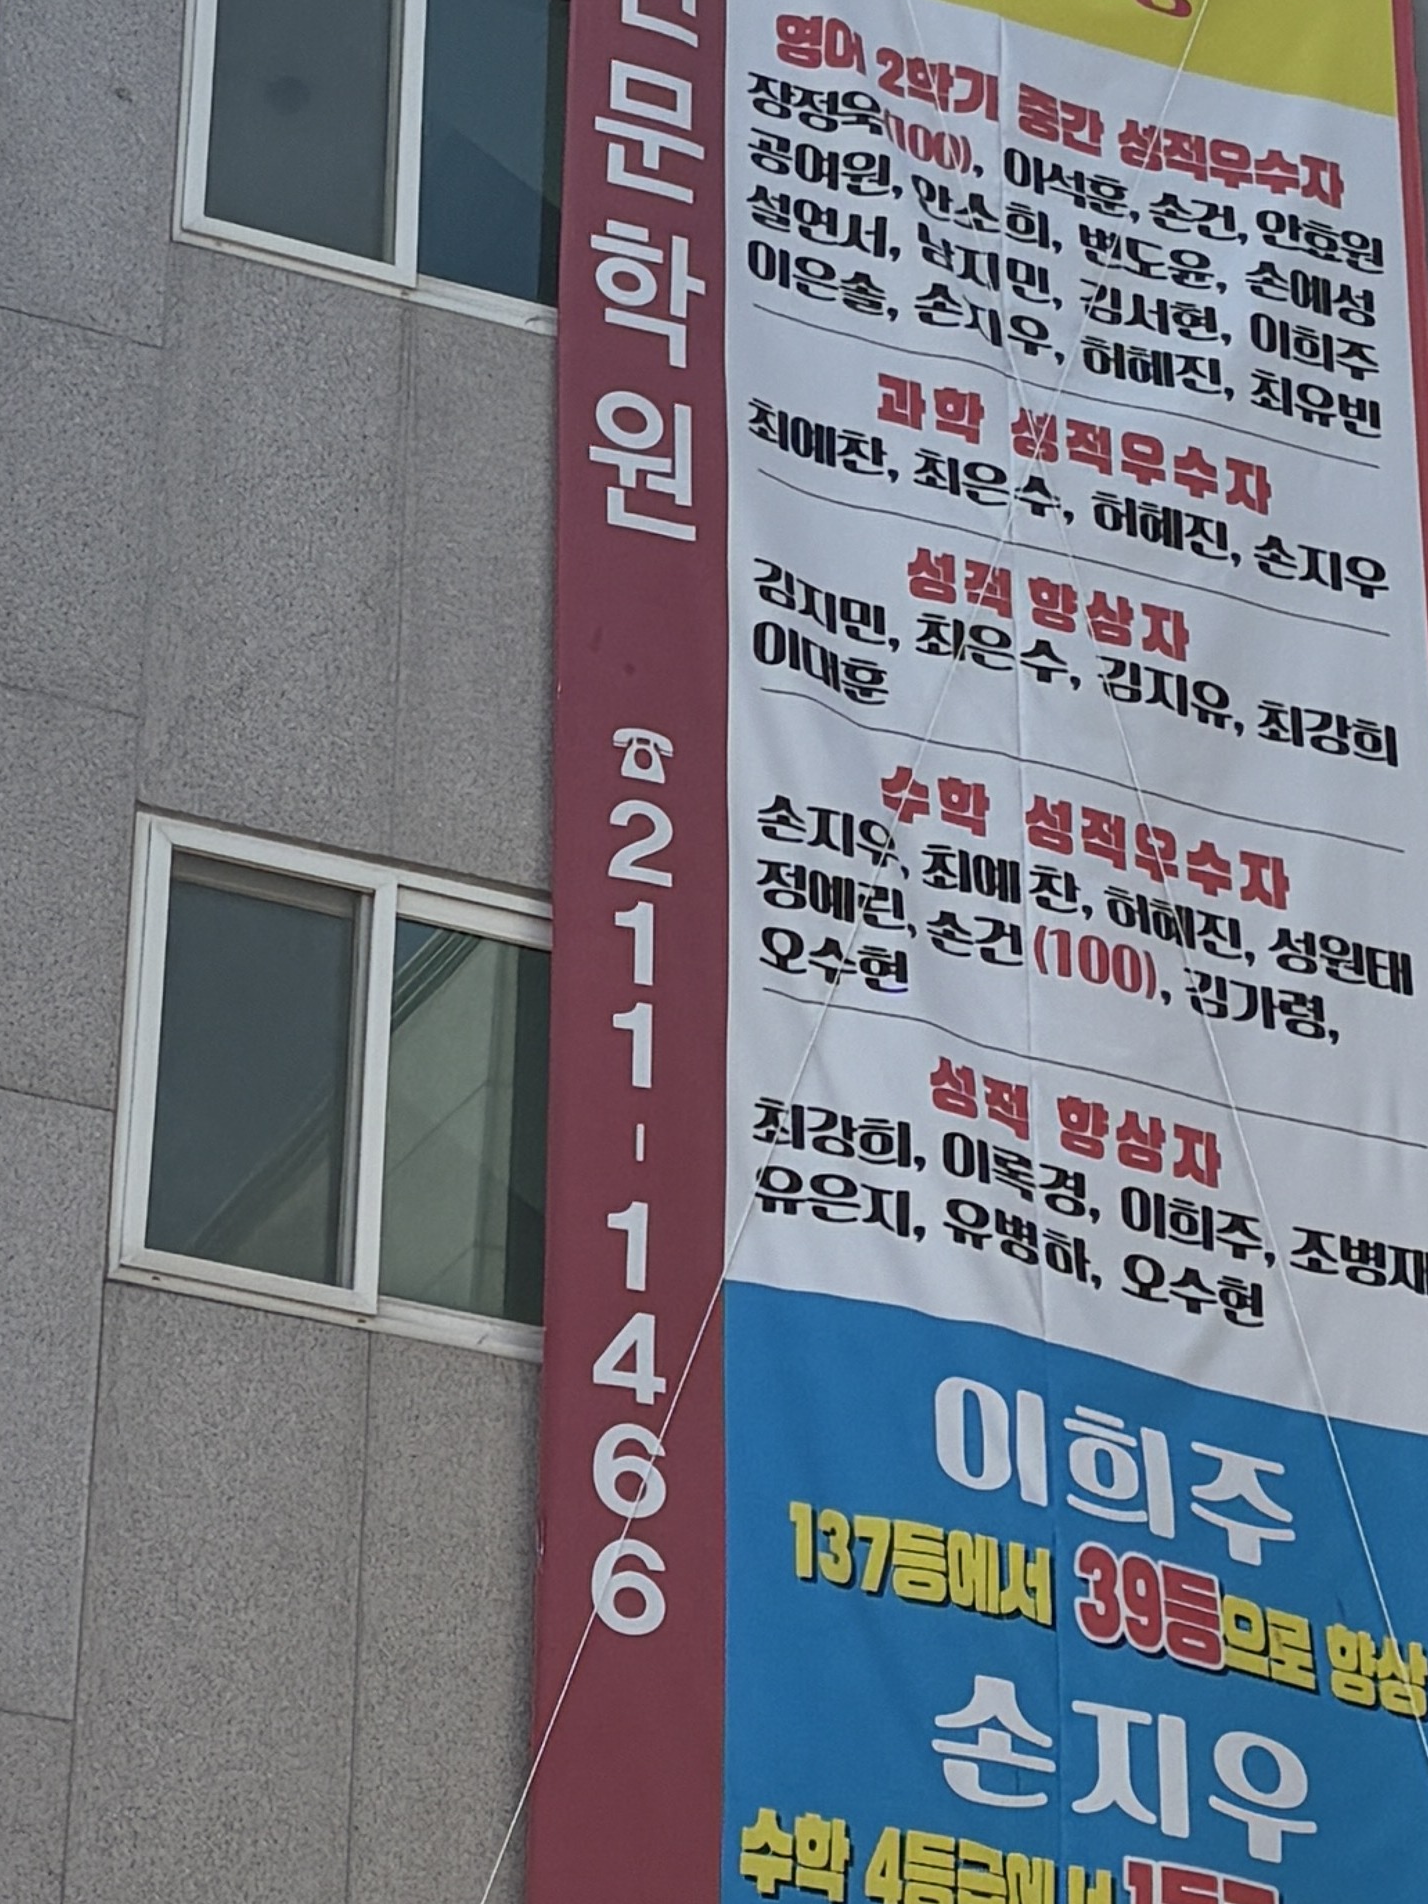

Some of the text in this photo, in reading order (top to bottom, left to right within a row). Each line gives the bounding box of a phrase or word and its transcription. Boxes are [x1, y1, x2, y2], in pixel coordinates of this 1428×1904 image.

[776, 14, 1345, 209] 영어 2학기 중간 성적우수자
[746, 184, 900, 262] 설연서,
[1079, 278, 1232, 346] 김서현,
[1250, 312, 1380, 381] 이희주
[747, 127, 1376, 326] 공여원, 안소희, 변도윤, 손예성
[1004, 147, 1139, 223] 이석훈,
[1148, 192, 1248, 246] 손건,
[1256, 210, 1384, 275] 안효원
[747, 240, 1381, 438] 이은솔, 손지우, 허혜진, 최유빈
[748, 397, 1389, 599] 최예찬, 최은수, 허혜진, 손지우
[877, 372, 1272, 516] 과학 성적우수자
[754, 557, 1399, 767] 김지민, 최은수, 김지유, 최강희
[907, 547, 1189, 661] 성적 향상자
[757, 795, 1414, 996] 손지우, 최예찬, 허혜진, 성원태
[881, 766, 1290, 910] 수학 성적우수자
[757, 859, 917, 938] 정예린,
[1184, 967, 1339, 1045] 김가령,
[760, 927, 908, 993] 오수현
[753, 1097, 926, 1172] 최강희,
[1121, 1186, 1276, 1268] 이희주,
[930, 1056, 1222, 1188] 성적 향상자
[756, 1166, 1264, 1328] 유은지, 유병하, 오수현
[935, 1376, 1296, 1566] 이희주
[789, 1501, 1054, 1627] 137등에서
[1074, 1541, 1318, 1691] 39등으로
[740, 1808, 850, 1902] 수학
[931, 1674, 1317, 1863] 손지우
